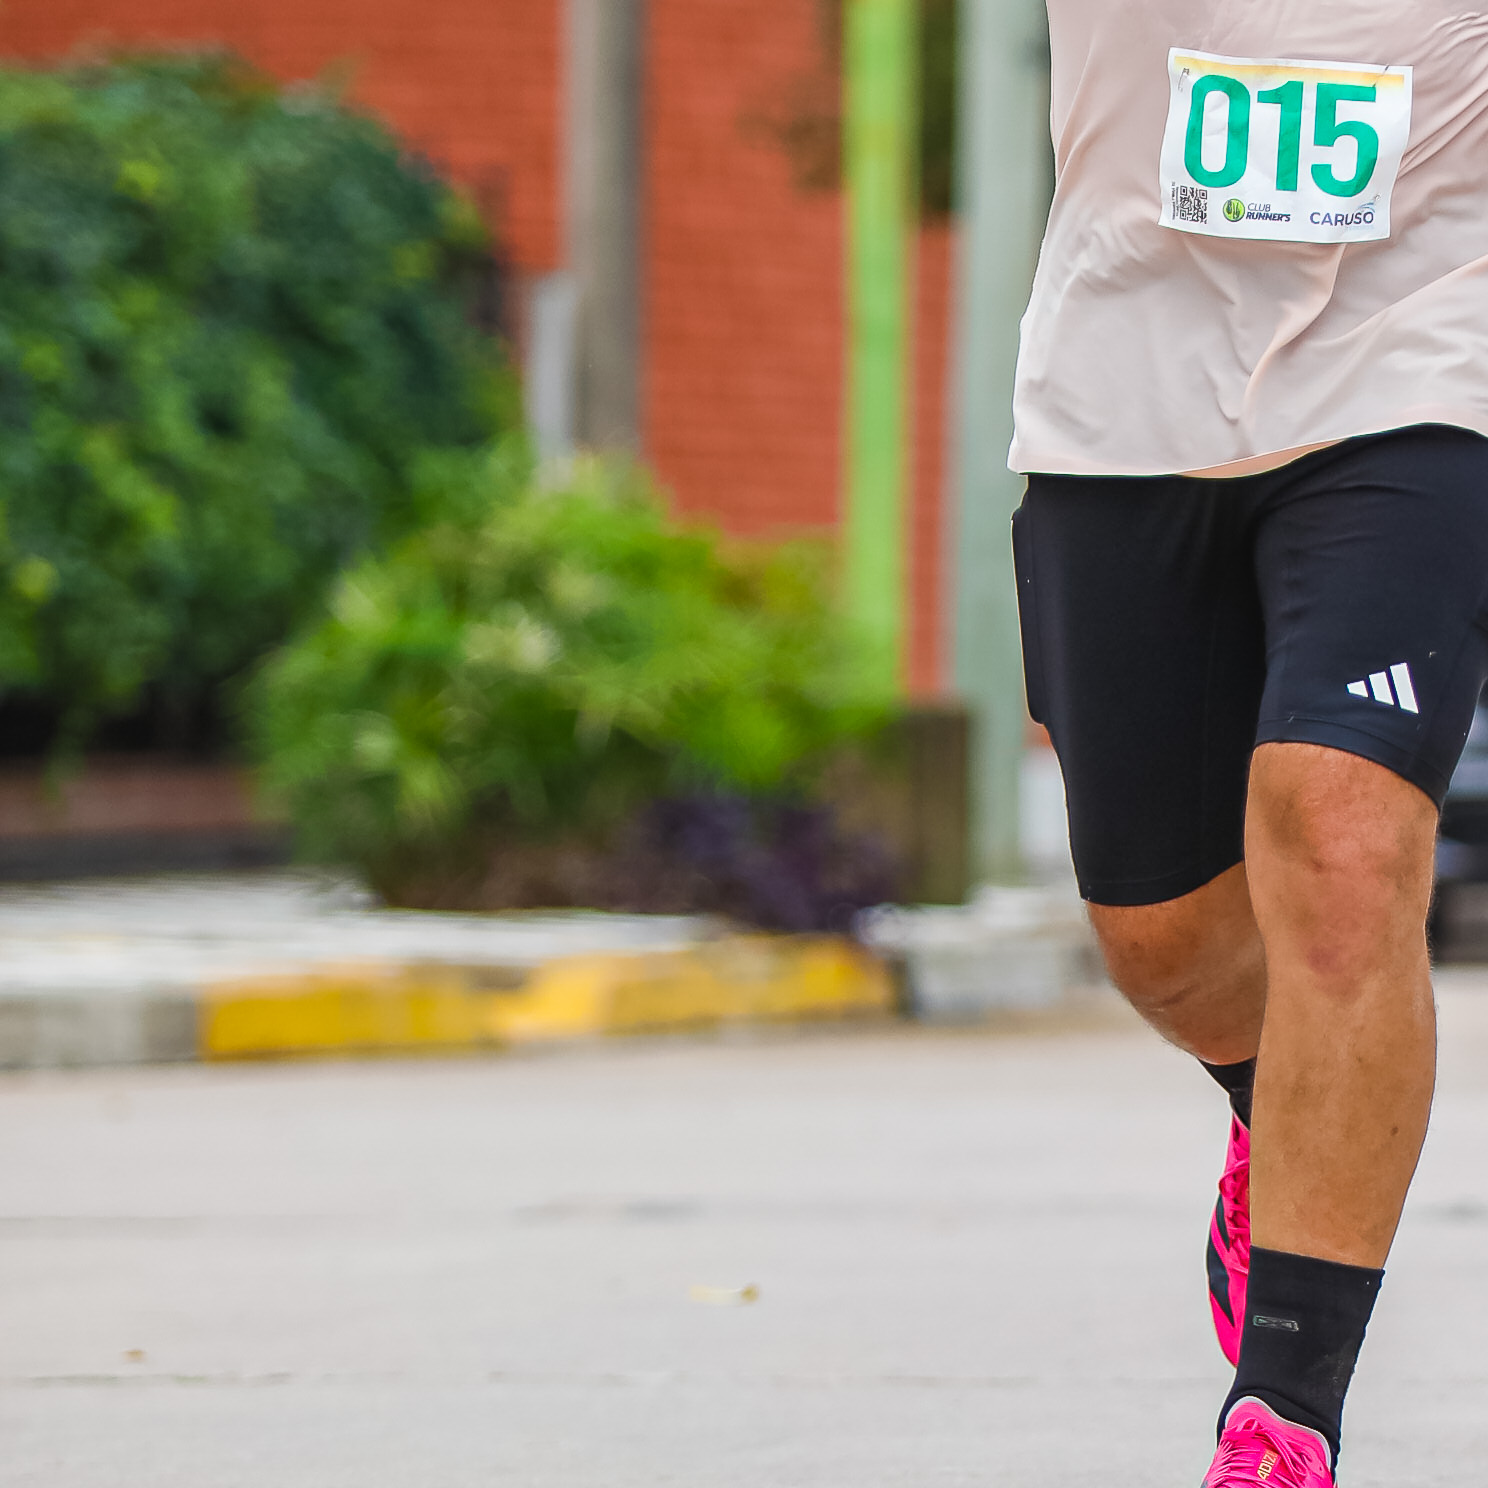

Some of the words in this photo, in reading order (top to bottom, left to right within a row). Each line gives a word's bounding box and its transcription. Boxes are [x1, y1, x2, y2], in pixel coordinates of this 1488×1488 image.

[1184, 74, 1379, 198] 015
[1247, 202, 1271, 212] CLUB
[1309, 211, 1375, 226] CARUSO
